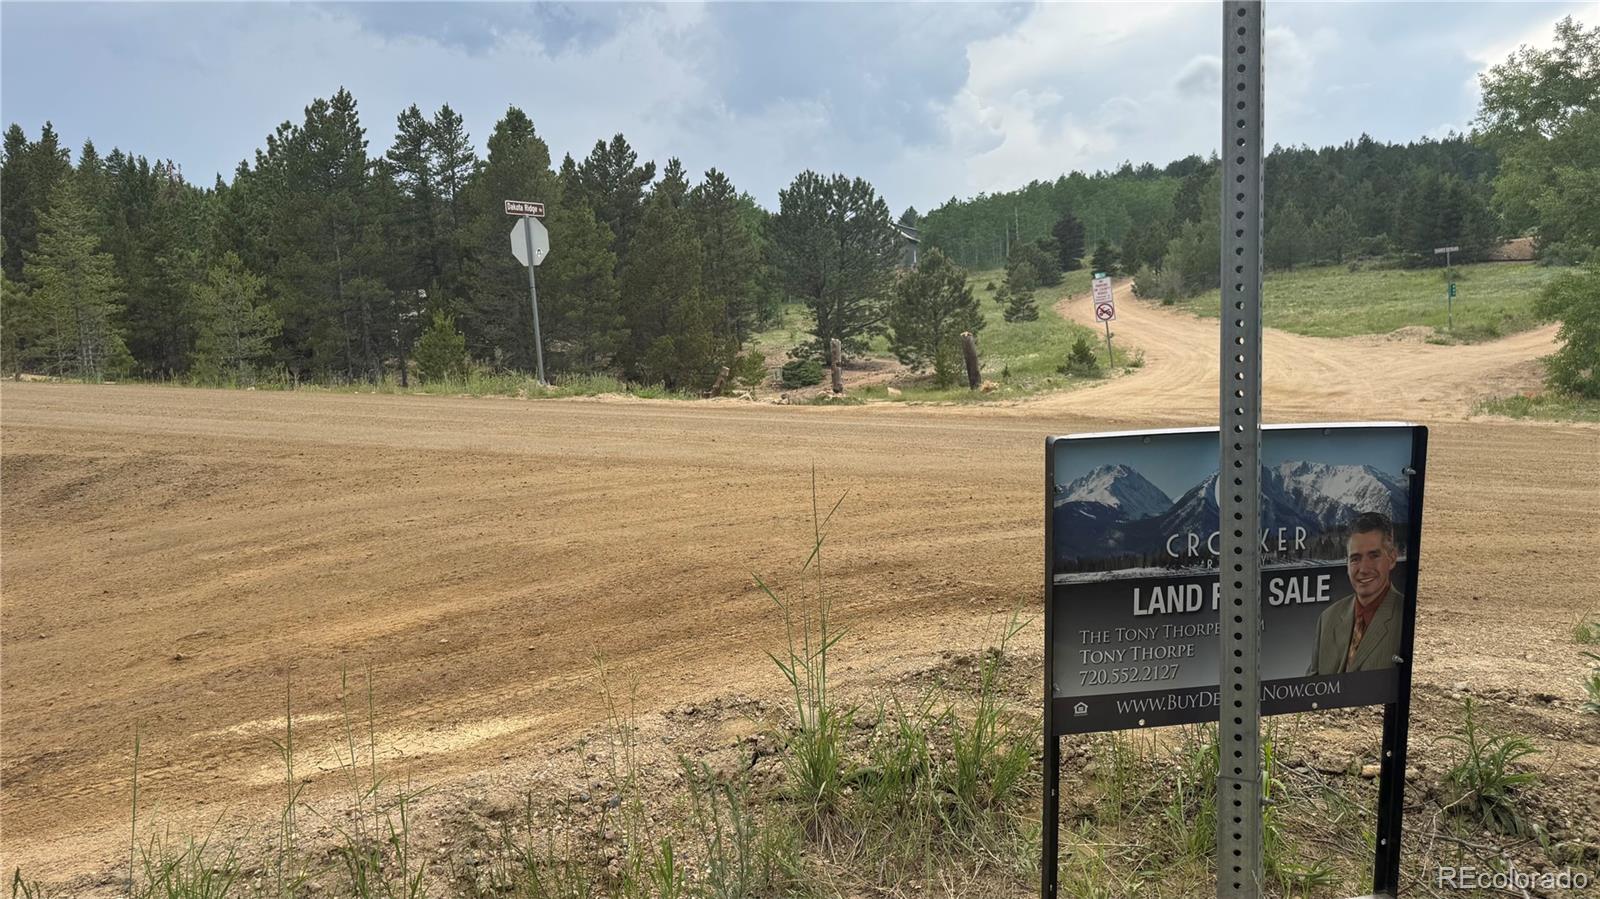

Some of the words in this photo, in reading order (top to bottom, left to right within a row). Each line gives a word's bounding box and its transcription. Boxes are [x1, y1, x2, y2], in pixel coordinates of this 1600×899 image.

[507, 202, 523, 211] Dakota
[524, 204, 538, 214] Ridge
[1133, 583, 1203, 616] LAND
[1268, 574, 1331, 606] SALE
[1079, 630, 1111, 644] THE
[1115, 626, 1159, 642] TONY
[1079, 649, 1127, 664] TONY
[1129, 643, 1195, 660] THORPE
[1079, 663, 1179, 685] 720.552.2127
